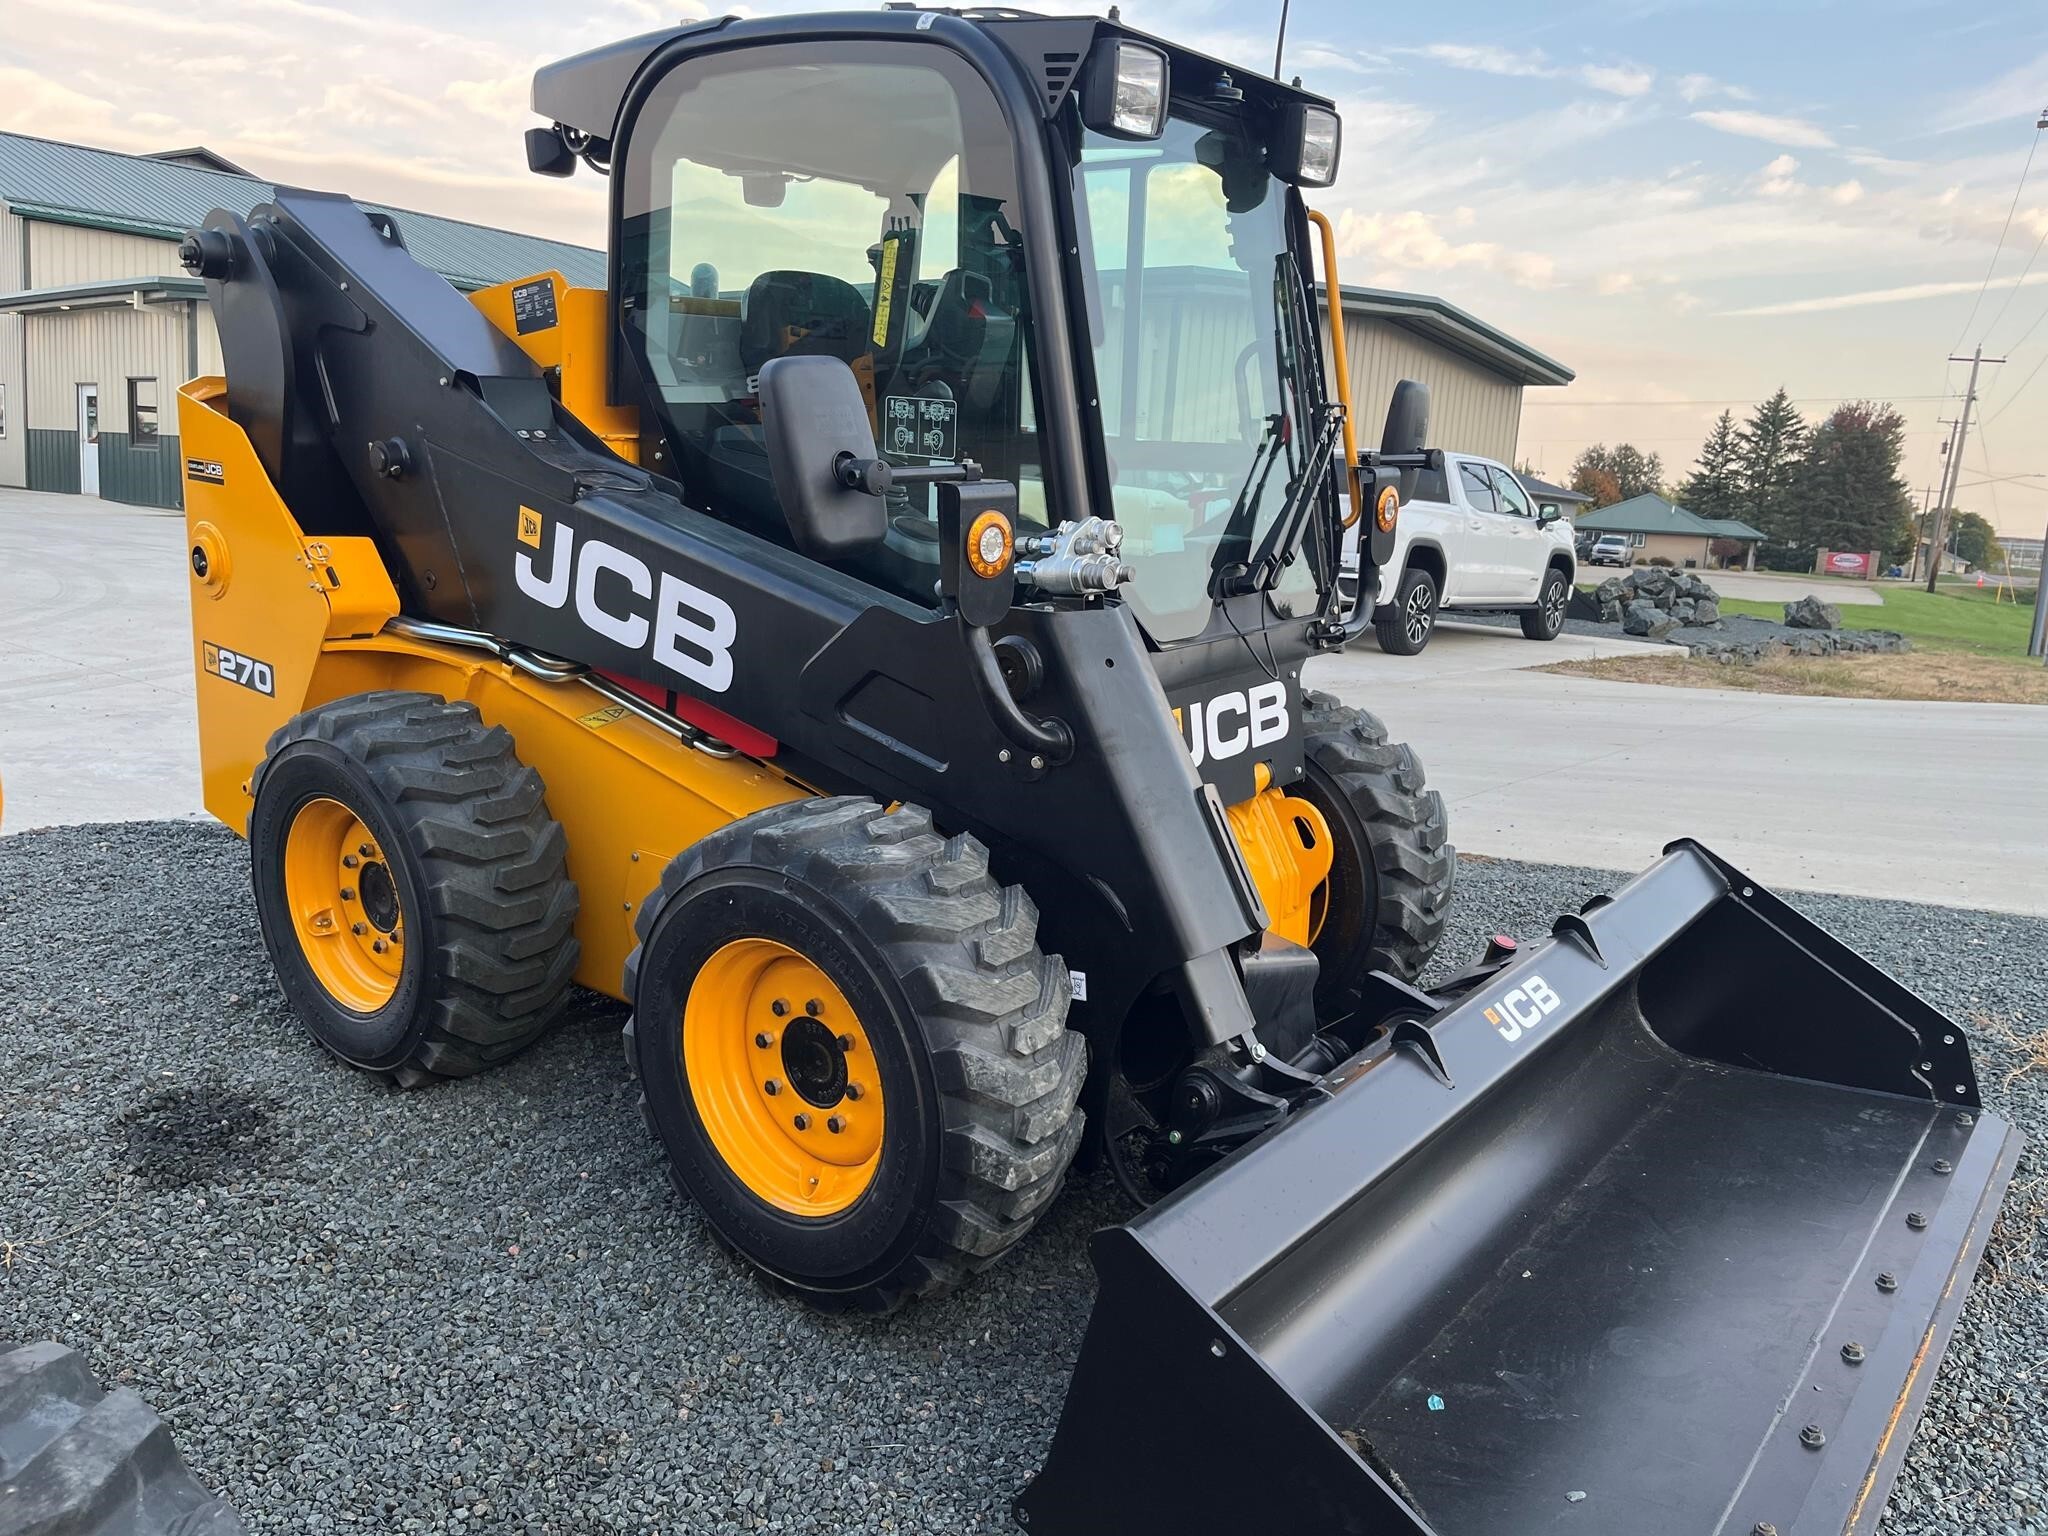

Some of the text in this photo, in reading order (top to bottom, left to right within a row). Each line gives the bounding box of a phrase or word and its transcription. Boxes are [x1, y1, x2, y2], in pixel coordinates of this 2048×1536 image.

[205, 464, 222, 476] JCB
[515, 521, 737, 693] JCB
[219, 649, 272, 694] 270
[1189, 680, 1290, 768] JCB
[1493, 975, 1561, 1042] JCB
